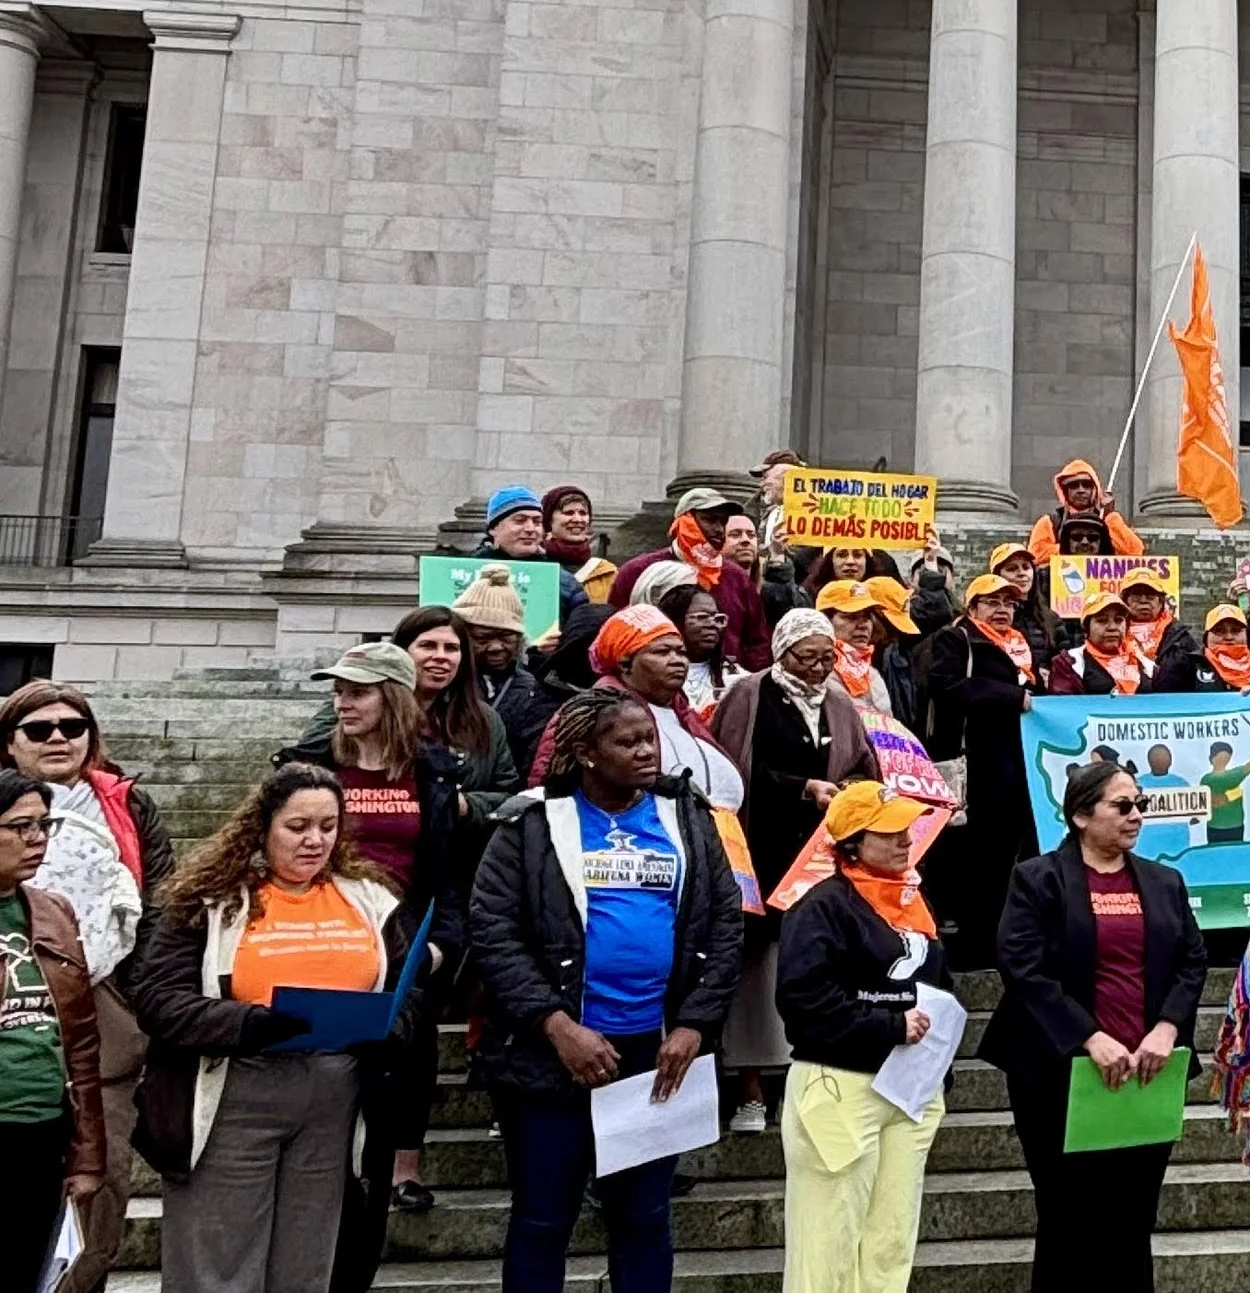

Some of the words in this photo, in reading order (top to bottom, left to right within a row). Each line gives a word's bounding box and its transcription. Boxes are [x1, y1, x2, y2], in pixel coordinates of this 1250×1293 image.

[793, 478, 806, 493] EL
[810, 478, 864, 496] TRABAJO
[867, 483, 887, 498] DEL
[891, 484, 929, 499] HOGAR
[818, 497, 856, 516] HACE
[865, 497, 901, 518] TODO
[786, 515, 807, 535] LO
[811, 514, 867, 538] DEMÁS
[870, 520, 931, 541] POSIBLE
[1098, 722, 1168, 741] DOMESTIC
[1173, 718, 1239, 740] WORKERS
[345, 800, 420, 814] SHINGTON
[1146, 791, 1207, 813] OALITION
